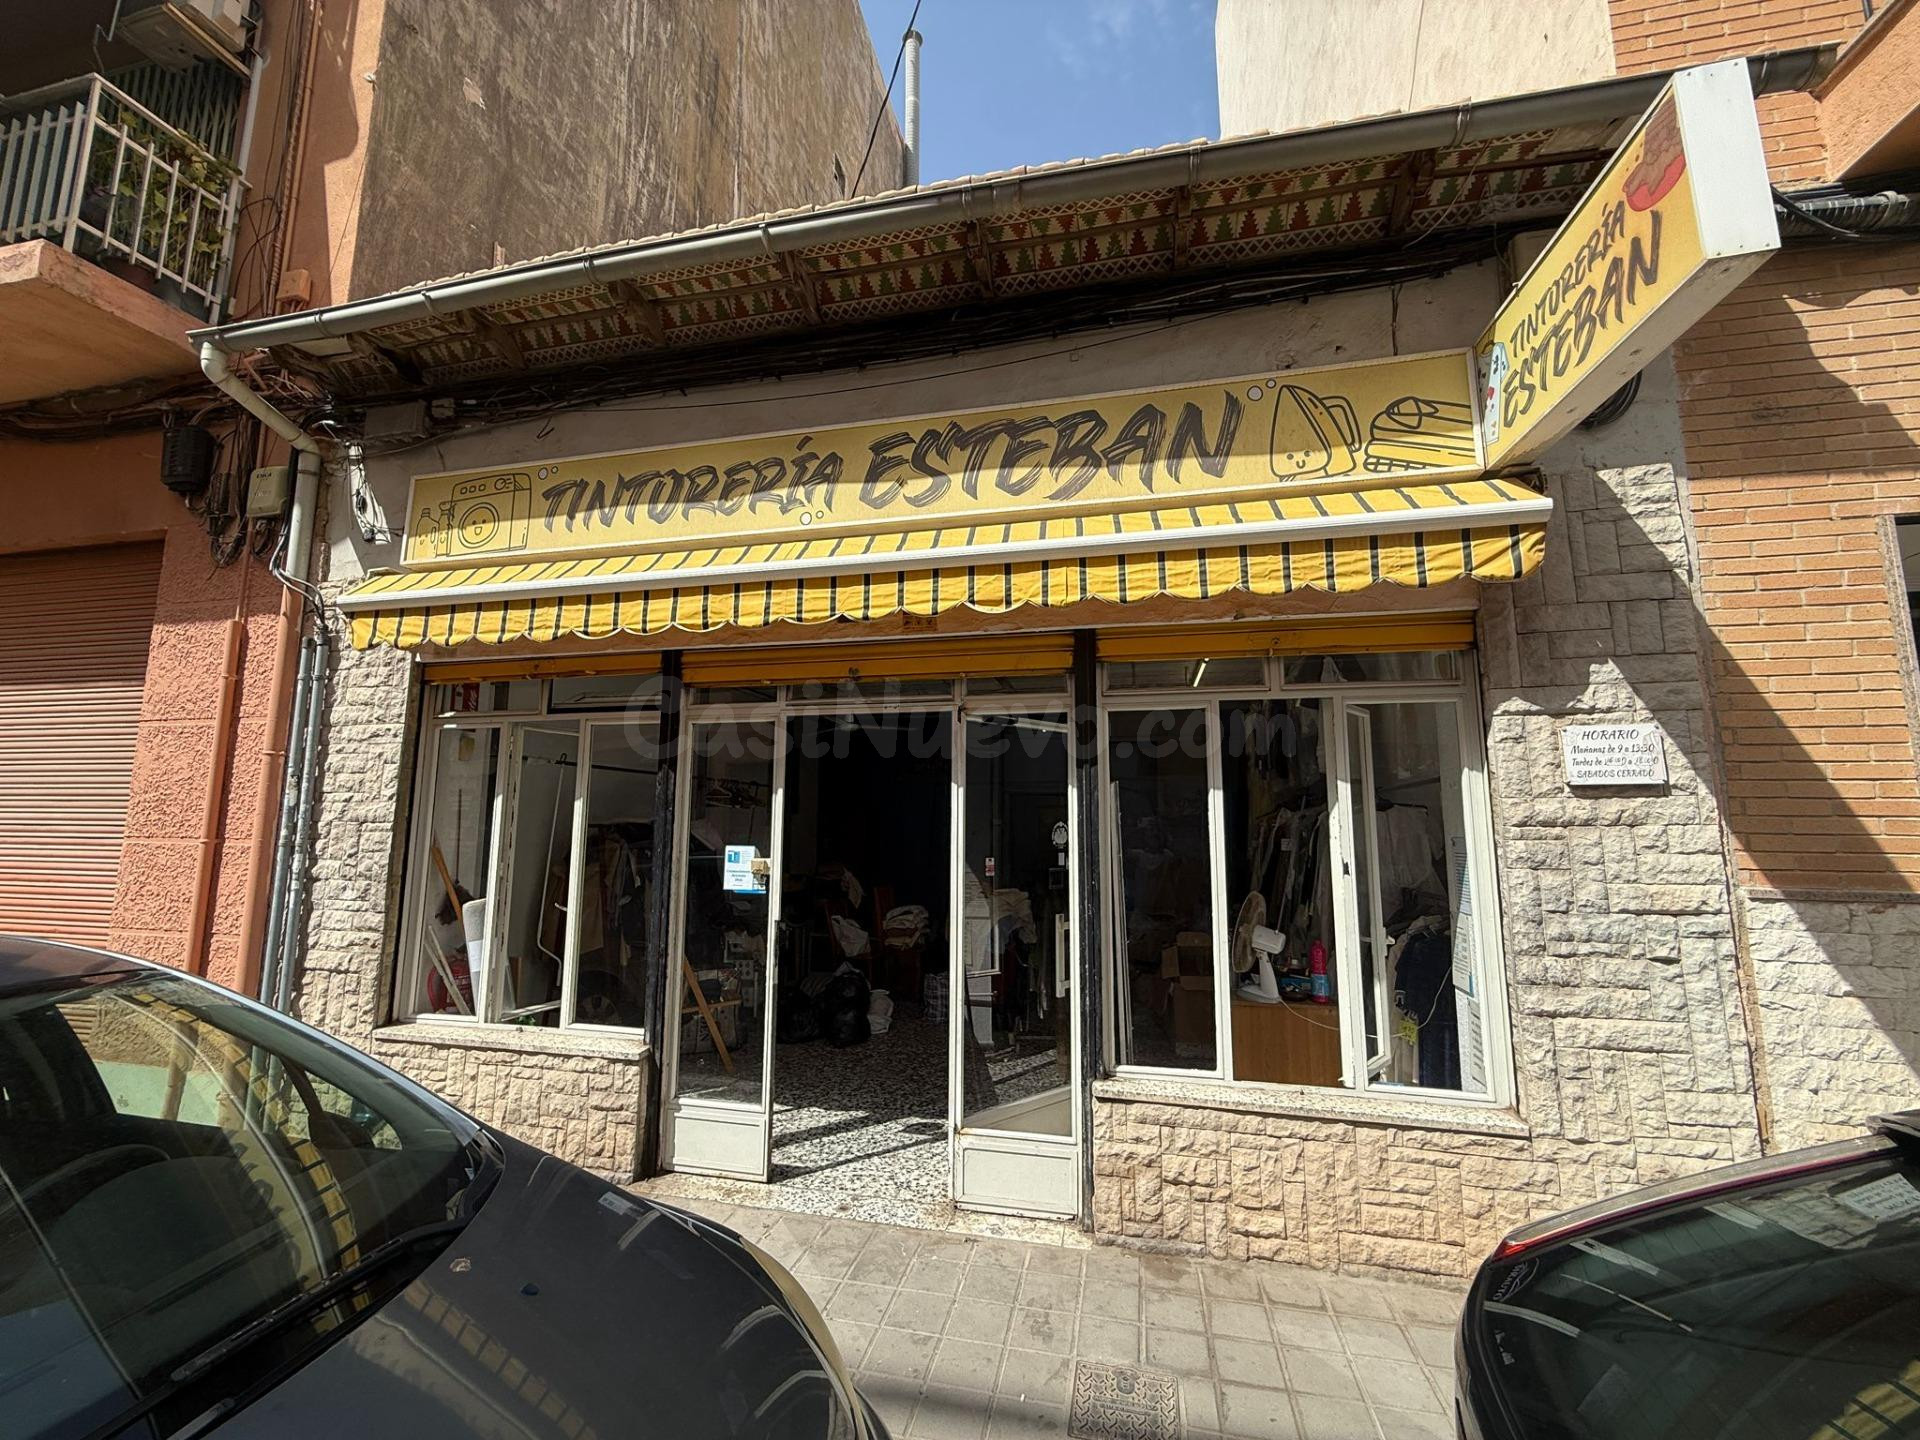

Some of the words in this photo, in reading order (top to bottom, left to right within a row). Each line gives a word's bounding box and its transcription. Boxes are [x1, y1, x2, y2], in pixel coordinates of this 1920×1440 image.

[1509, 200, 1625, 359] TINTORERÍA
[1502, 209, 1660, 428] ESTEBAN
[541, 435, 844, 533] TINTORERÍA
[859, 388, 1246, 509] ESTEBAN
[1581, 729, 1640, 740] HORARIO
[1607, 744, 1616, 753] de
[1618, 744, 1623, 753] 9
[1631, 743, 1655, 753] 13:30
[1572, 757, 1593, 766] Tardes
[1595, 757, 1602, 766] de
[1616, 768, 1655, 778] CERRADO
